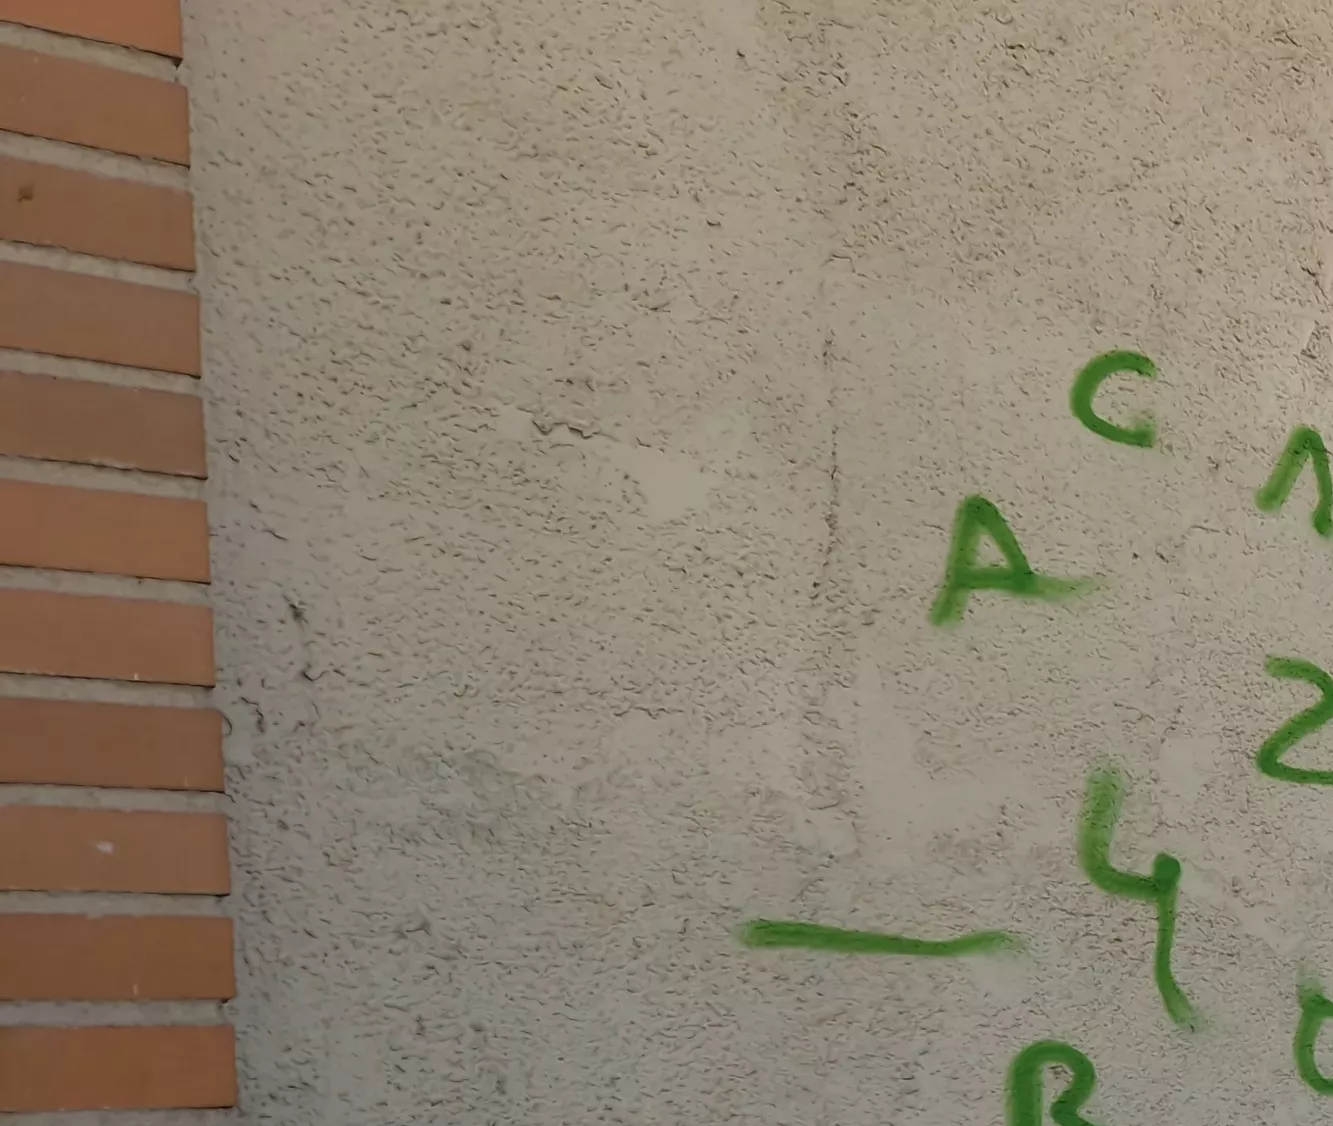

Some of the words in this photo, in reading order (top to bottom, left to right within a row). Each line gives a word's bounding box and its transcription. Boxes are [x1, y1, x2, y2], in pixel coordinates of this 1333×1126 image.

[1071, 352, 1156, 449] C
[932, 497, 1076, 625] A
[1082, 776, 1194, 1025] 4
